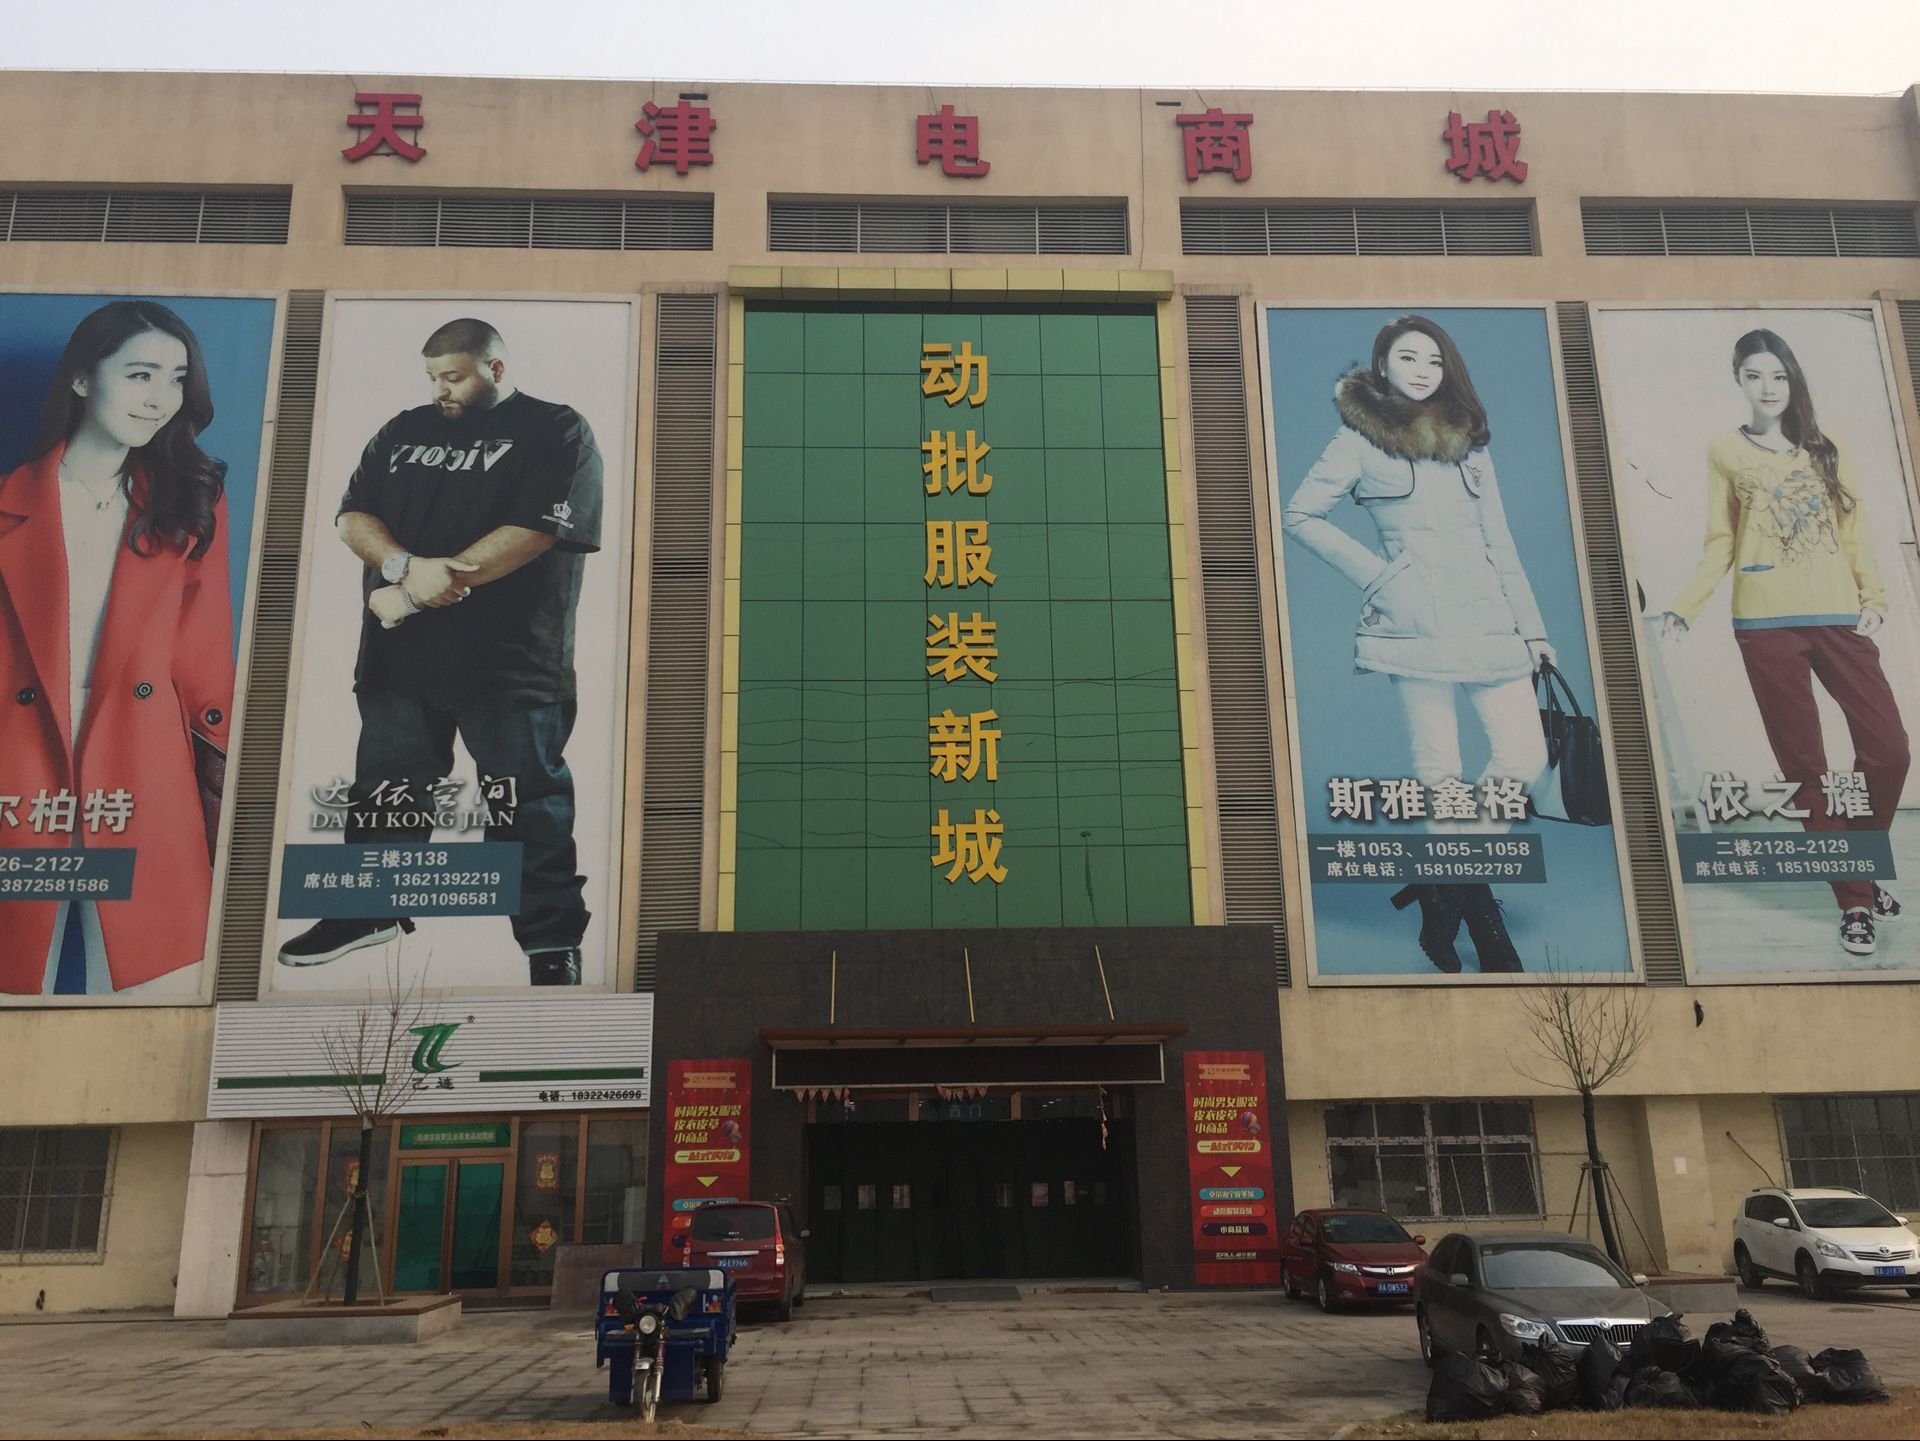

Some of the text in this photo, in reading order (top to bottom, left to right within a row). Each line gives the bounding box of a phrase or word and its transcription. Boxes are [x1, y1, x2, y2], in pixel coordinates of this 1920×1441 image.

[341, 92, 1528, 184] 天津电商城
[920, 341, 1008, 884] 动批服装新城
[312, 774, 518, 808] 达依空间
[1328, 777, 1529, 820] 斯雅鑫格
[1699, 770, 1874, 821] 依之耀
[312, 810, 515, 831] DA YI KONG JIAN
[1716, 840, 1849, 857] 二楼2128-2129
[361, 850, 448, 868] 三楼3138
[390, 892, 497, 906] 18201096581
[1193, 1096, 1258, 1108] 时尚男女服装
[674, 1105, 741, 1117] 时尚男女服装
[1194, 1109, 1237, 1121] 皮衣皮草
[674, 1119, 720, 1130] 皮衣皮草
[1195, 1122, 1228, 1134] 小商品
[674, 1131, 708, 1144] 小商品
